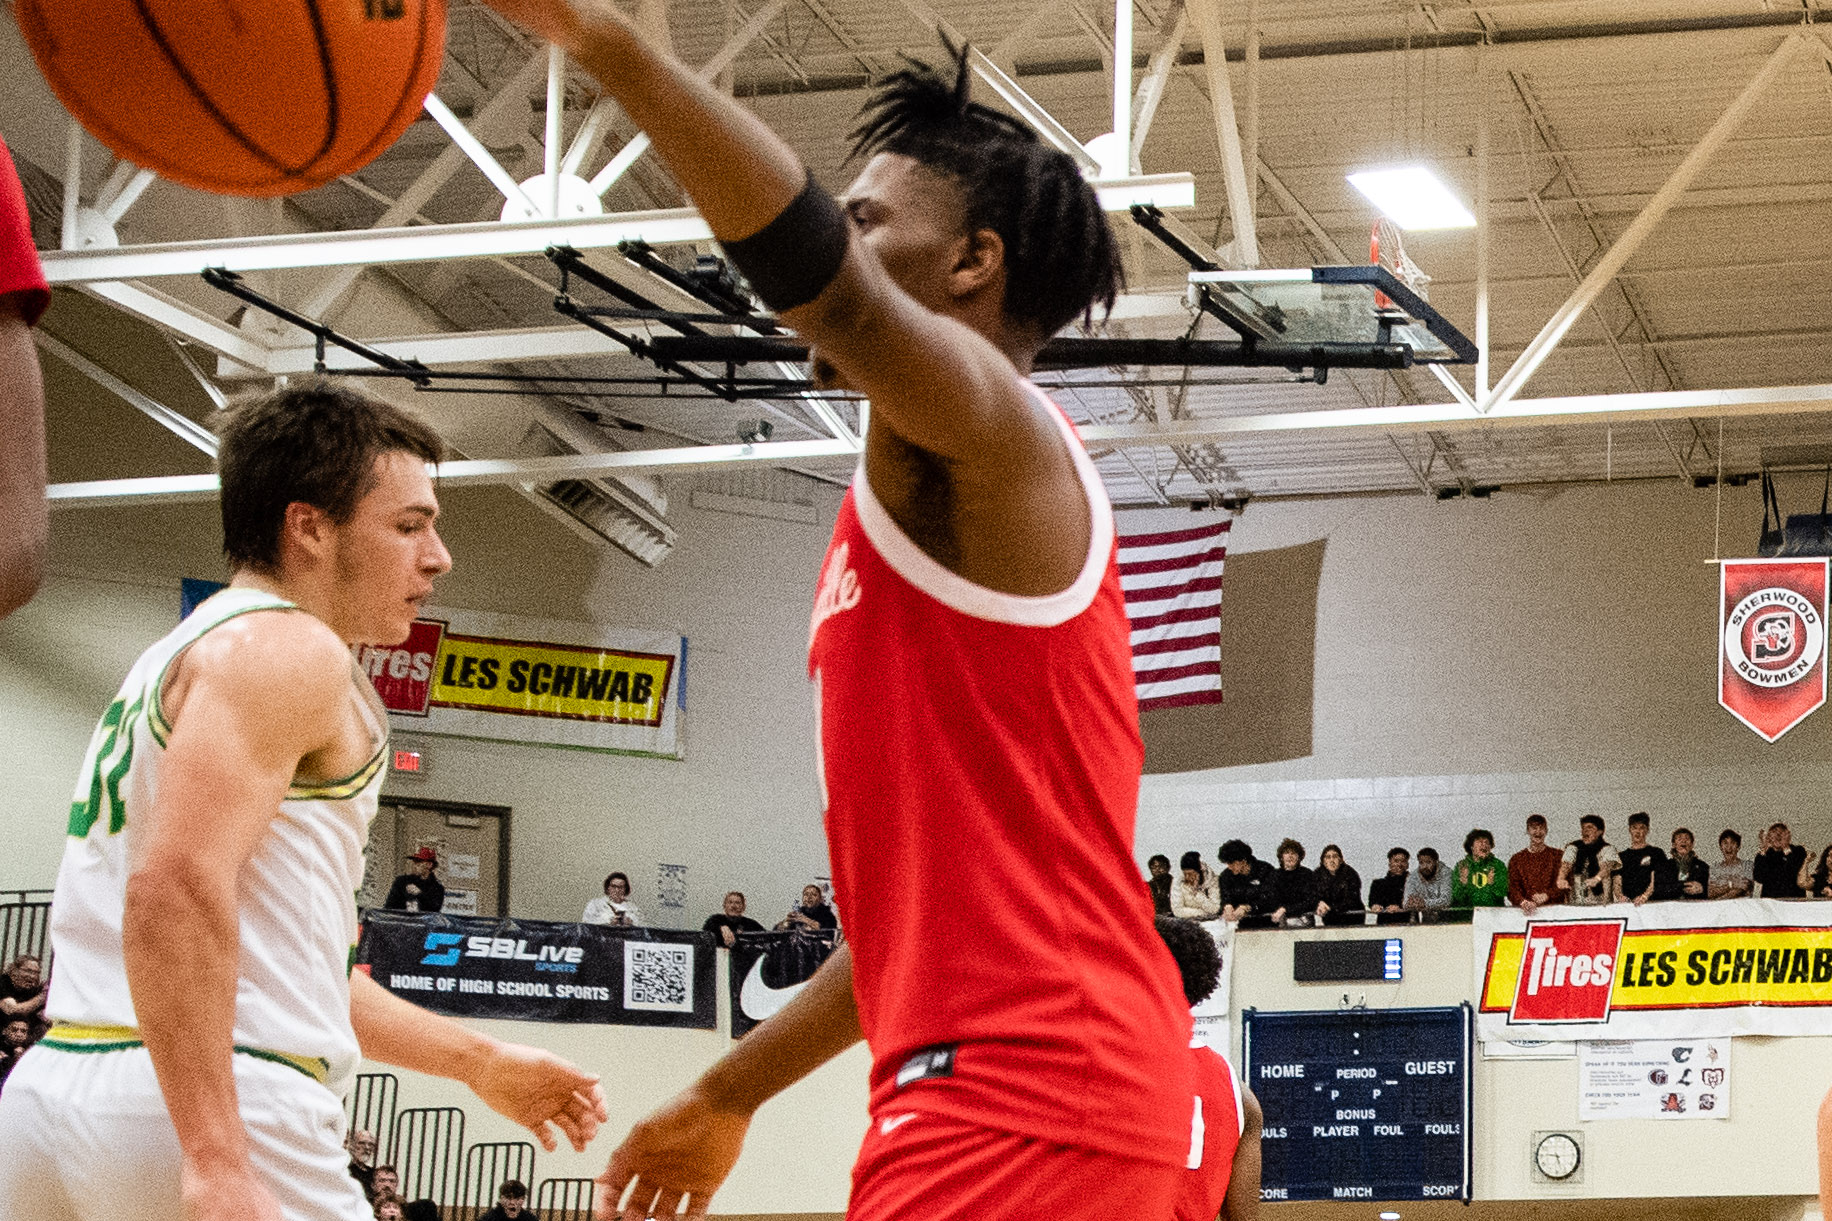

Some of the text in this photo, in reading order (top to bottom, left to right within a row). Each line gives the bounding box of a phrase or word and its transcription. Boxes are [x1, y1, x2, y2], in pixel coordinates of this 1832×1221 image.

[1732, 591, 1816, 627] SHERWOOD
[440, 653, 654, 705] LES SCHWAB
[1738, 659, 1810, 683] BOWMEN
[1527, 937, 1613, 996] Tires
[1621, 950, 1678, 988] LES
[390, 974, 610, 1001] HOME OF HIGH SCHOOL SPORTS
[1261, 1060, 1456, 1080] HOME PERIOD GUEST
[1336, 1109, 1376, 1120] BONUS
[1313, 1125, 1359, 1137] PLAYER
[1373, 1125, 1404, 1136] FOUL
[1259, 1185, 1460, 1199] CORE MATCH SCOR
